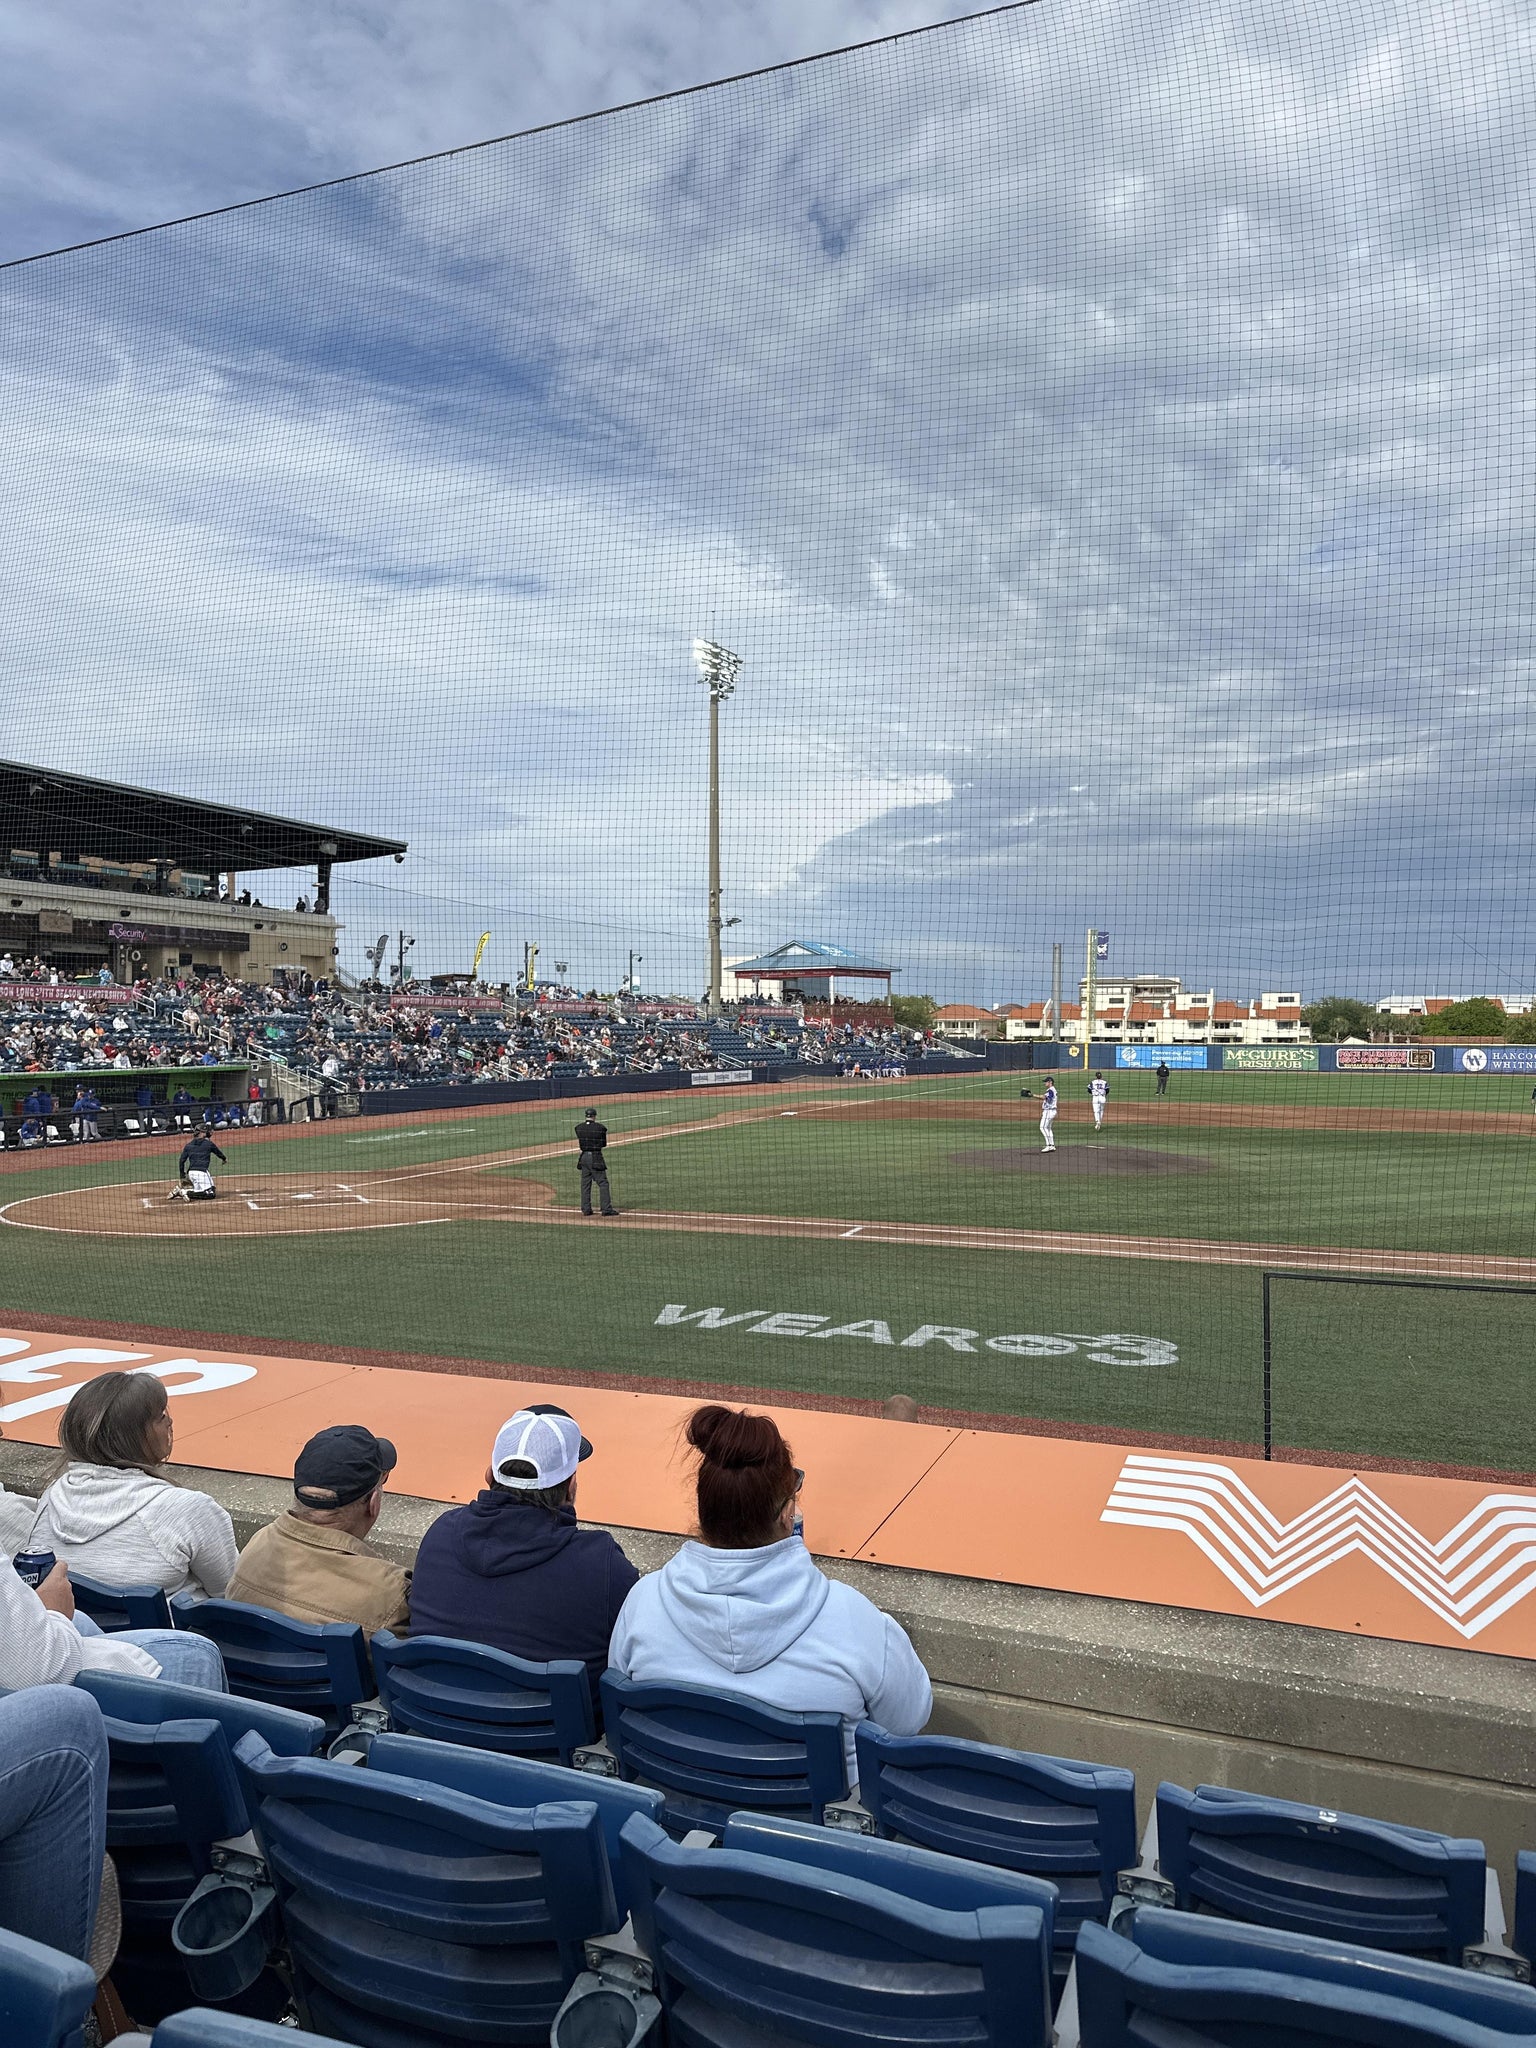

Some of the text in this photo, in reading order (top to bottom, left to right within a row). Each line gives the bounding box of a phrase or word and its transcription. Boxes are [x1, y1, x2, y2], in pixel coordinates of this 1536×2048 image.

[119, 928, 145, 941] Security
[16, 987, 35, 998] LONG
[1225, 1048, 1315, 1061] McGUIRE'S
[1238, 1060, 1302, 1069] IRISH PUB
[653, 1303, 980, 1353] WEAR
[1086, 1333, 1180, 1366] 3
